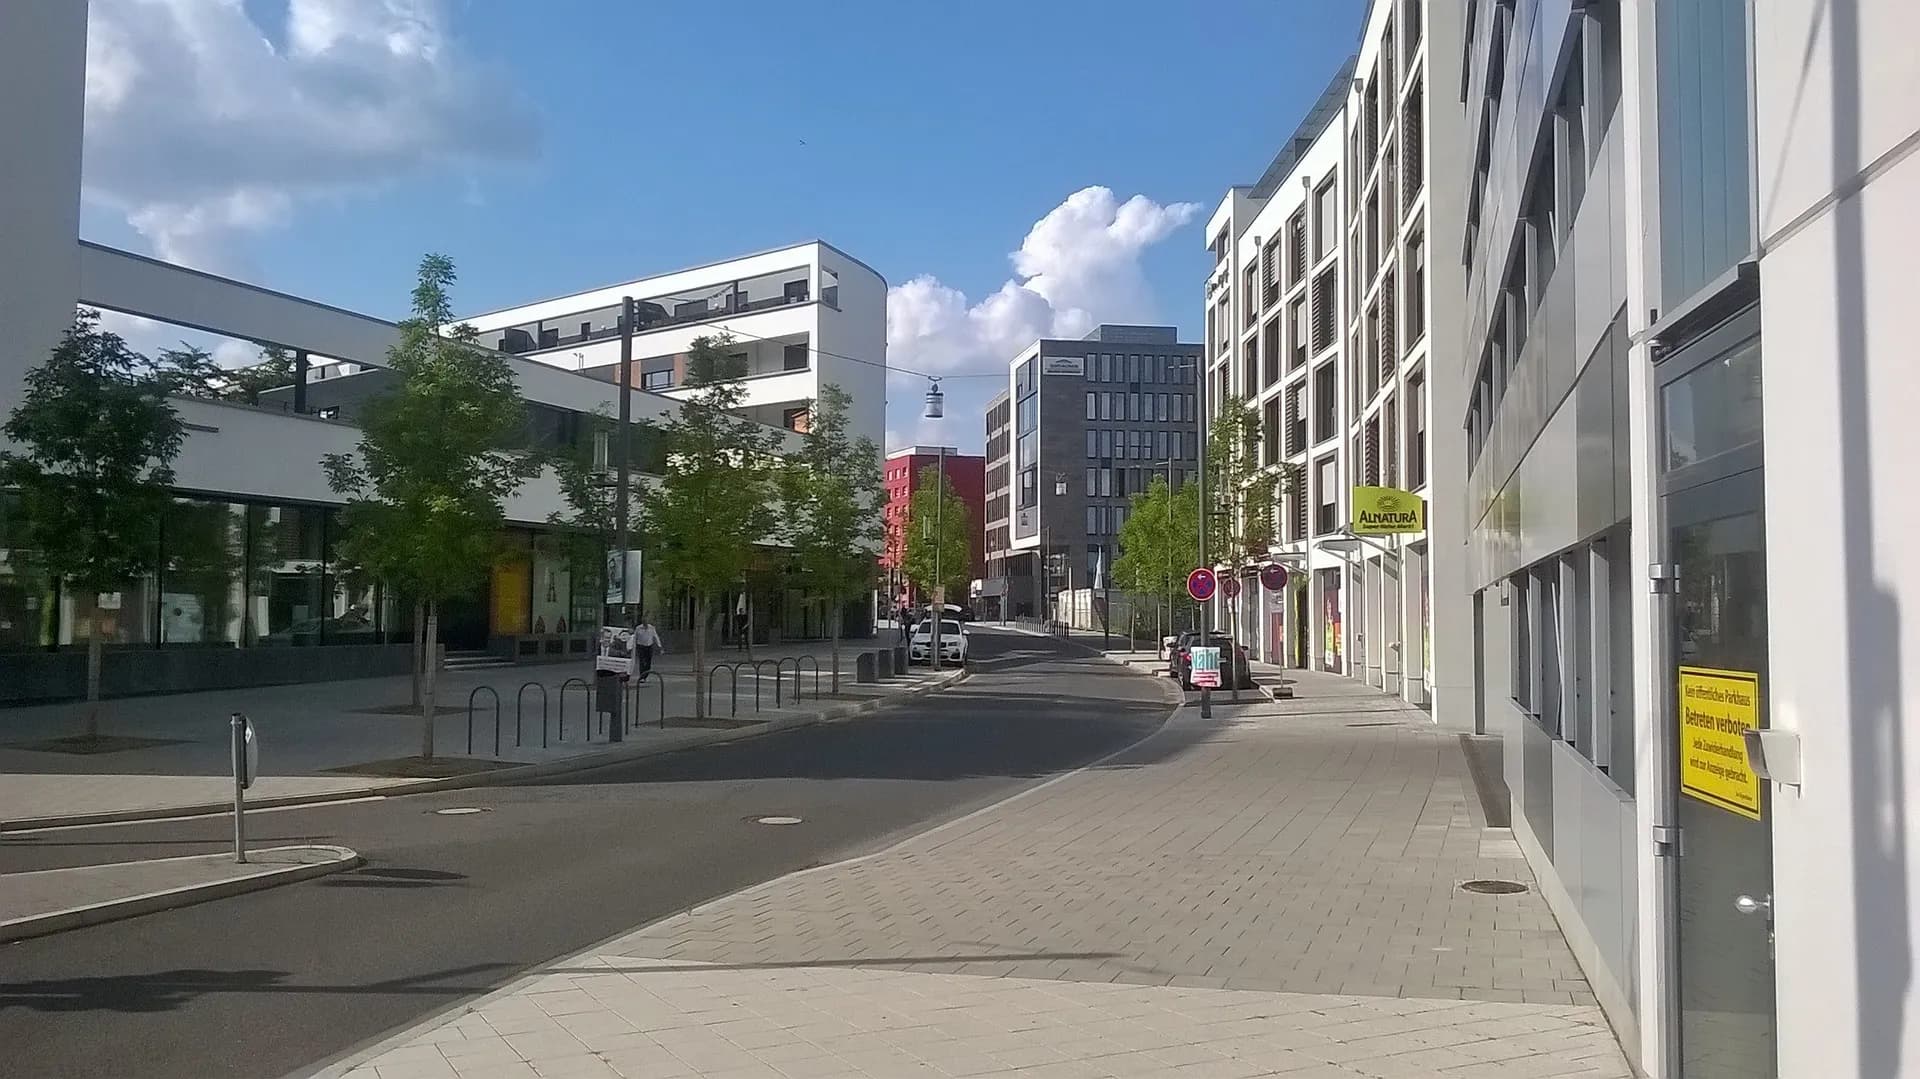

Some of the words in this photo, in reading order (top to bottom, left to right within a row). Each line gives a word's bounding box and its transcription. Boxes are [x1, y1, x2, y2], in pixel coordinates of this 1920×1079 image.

[1360, 510, 1416, 523] ALNATURA
[1725, 689, 1751, 706] Parkhaus
[1686, 706, 1714, 730] Betreten
